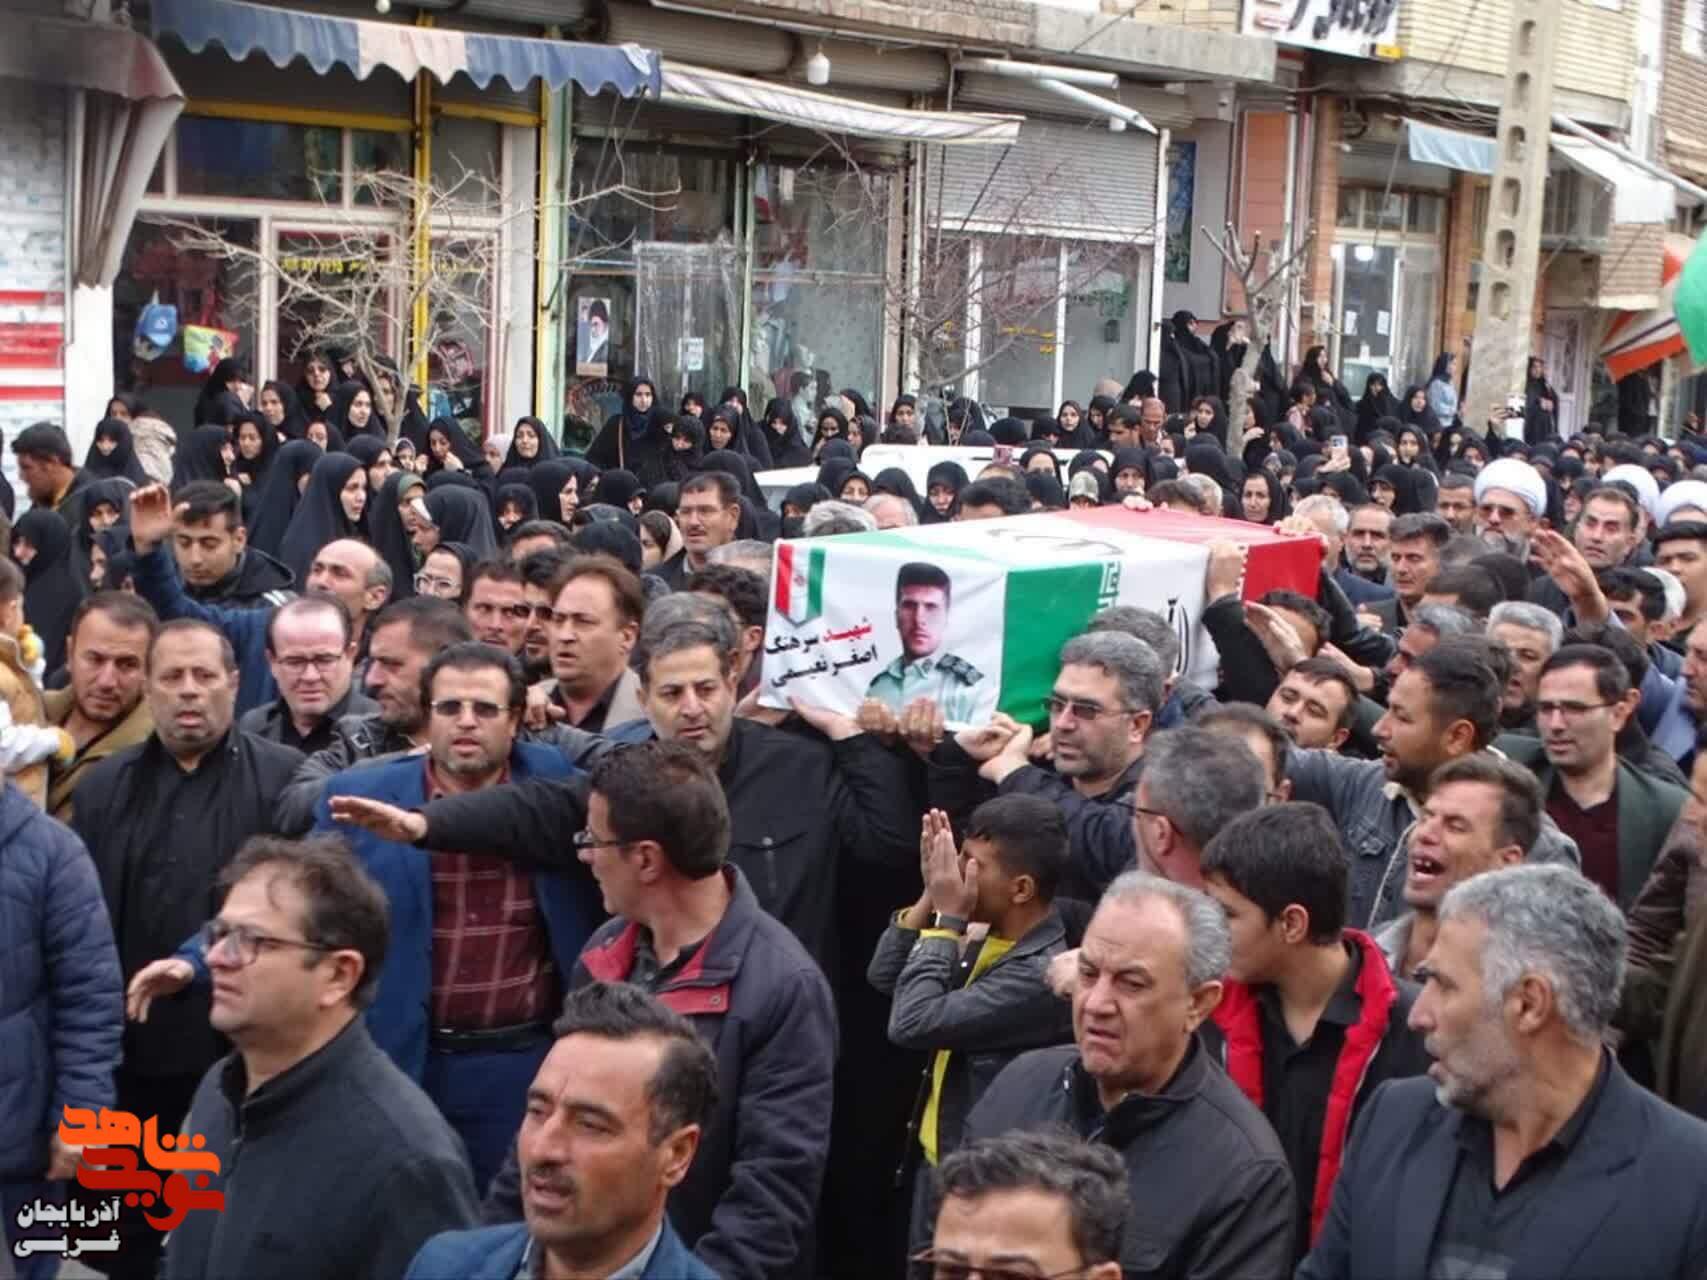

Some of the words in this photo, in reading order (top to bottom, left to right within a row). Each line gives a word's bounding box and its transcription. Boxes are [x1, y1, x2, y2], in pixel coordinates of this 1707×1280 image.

[823, 617, 873, 642] شهید
[765, 634, 819, 654] سرهنگ
[832, 645, 878, 676] اصغر
